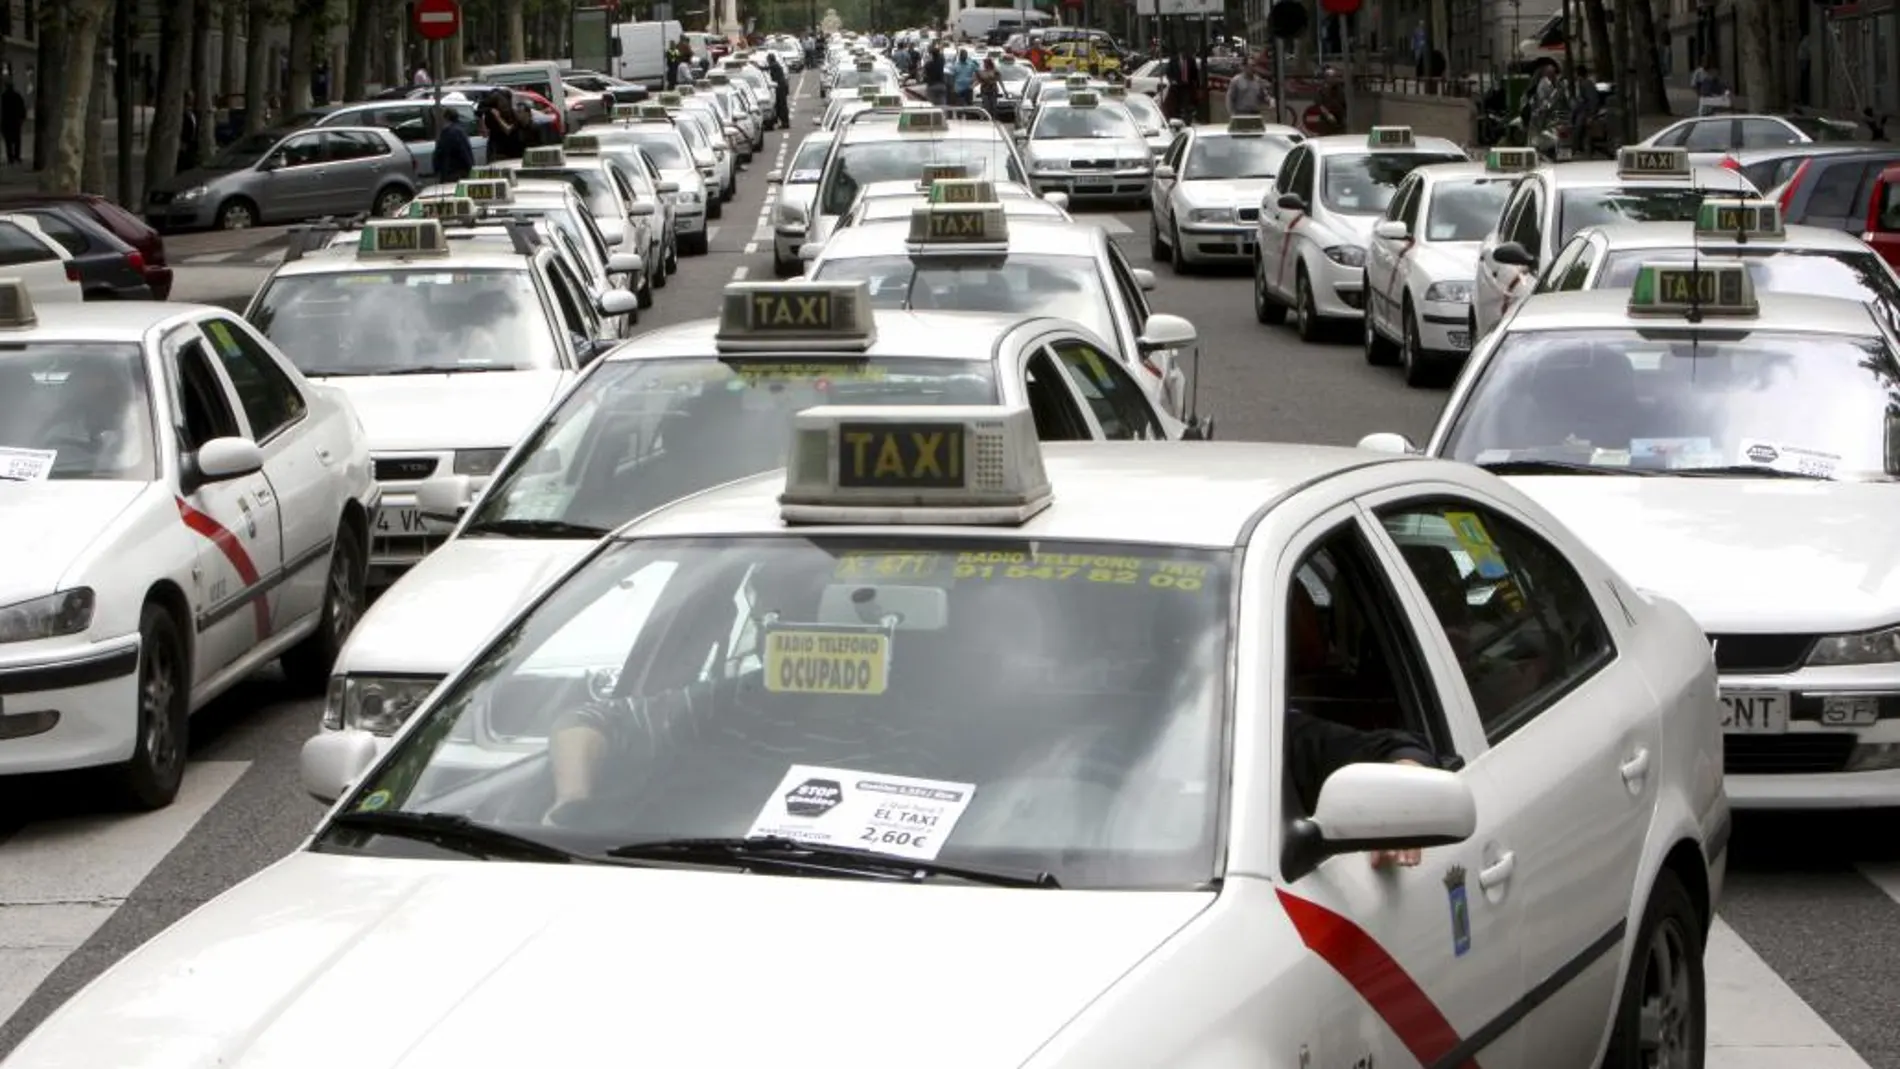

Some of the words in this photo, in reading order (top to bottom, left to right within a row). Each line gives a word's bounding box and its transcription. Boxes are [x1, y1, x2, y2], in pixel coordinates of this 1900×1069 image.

[1640, 154, 1673, 168] TAXI
[468, 184, 493, 200] TAXI
[933, 213, 980, 235] TAXI
[1721, 211, 1752, 228] TAI
[379, 227, 416, 250] TAXI
[755, 296, 828, 325] TAXI
[843, 431, 959, 478] TAXI
[957, 551, 1025, 565] RADIO
[1034, 552, 1141, 571] TELEFONO
[1159, 560, 1208, 578] TAXI
[953, 563, 993, 582] 91
[1149, 573, 1202, 590] 00
[776, 634, 814, 653] RADIO
[819, 636, 879, 655] TELEFONO
[780, 656, 870, 690] OCUPADO
[796, 785, 839, 797] STOP
[874, 808, 891, 821] EL
[899, 811, 940, 827] TAXI
[859, 827, 927, 849] 2,60€
